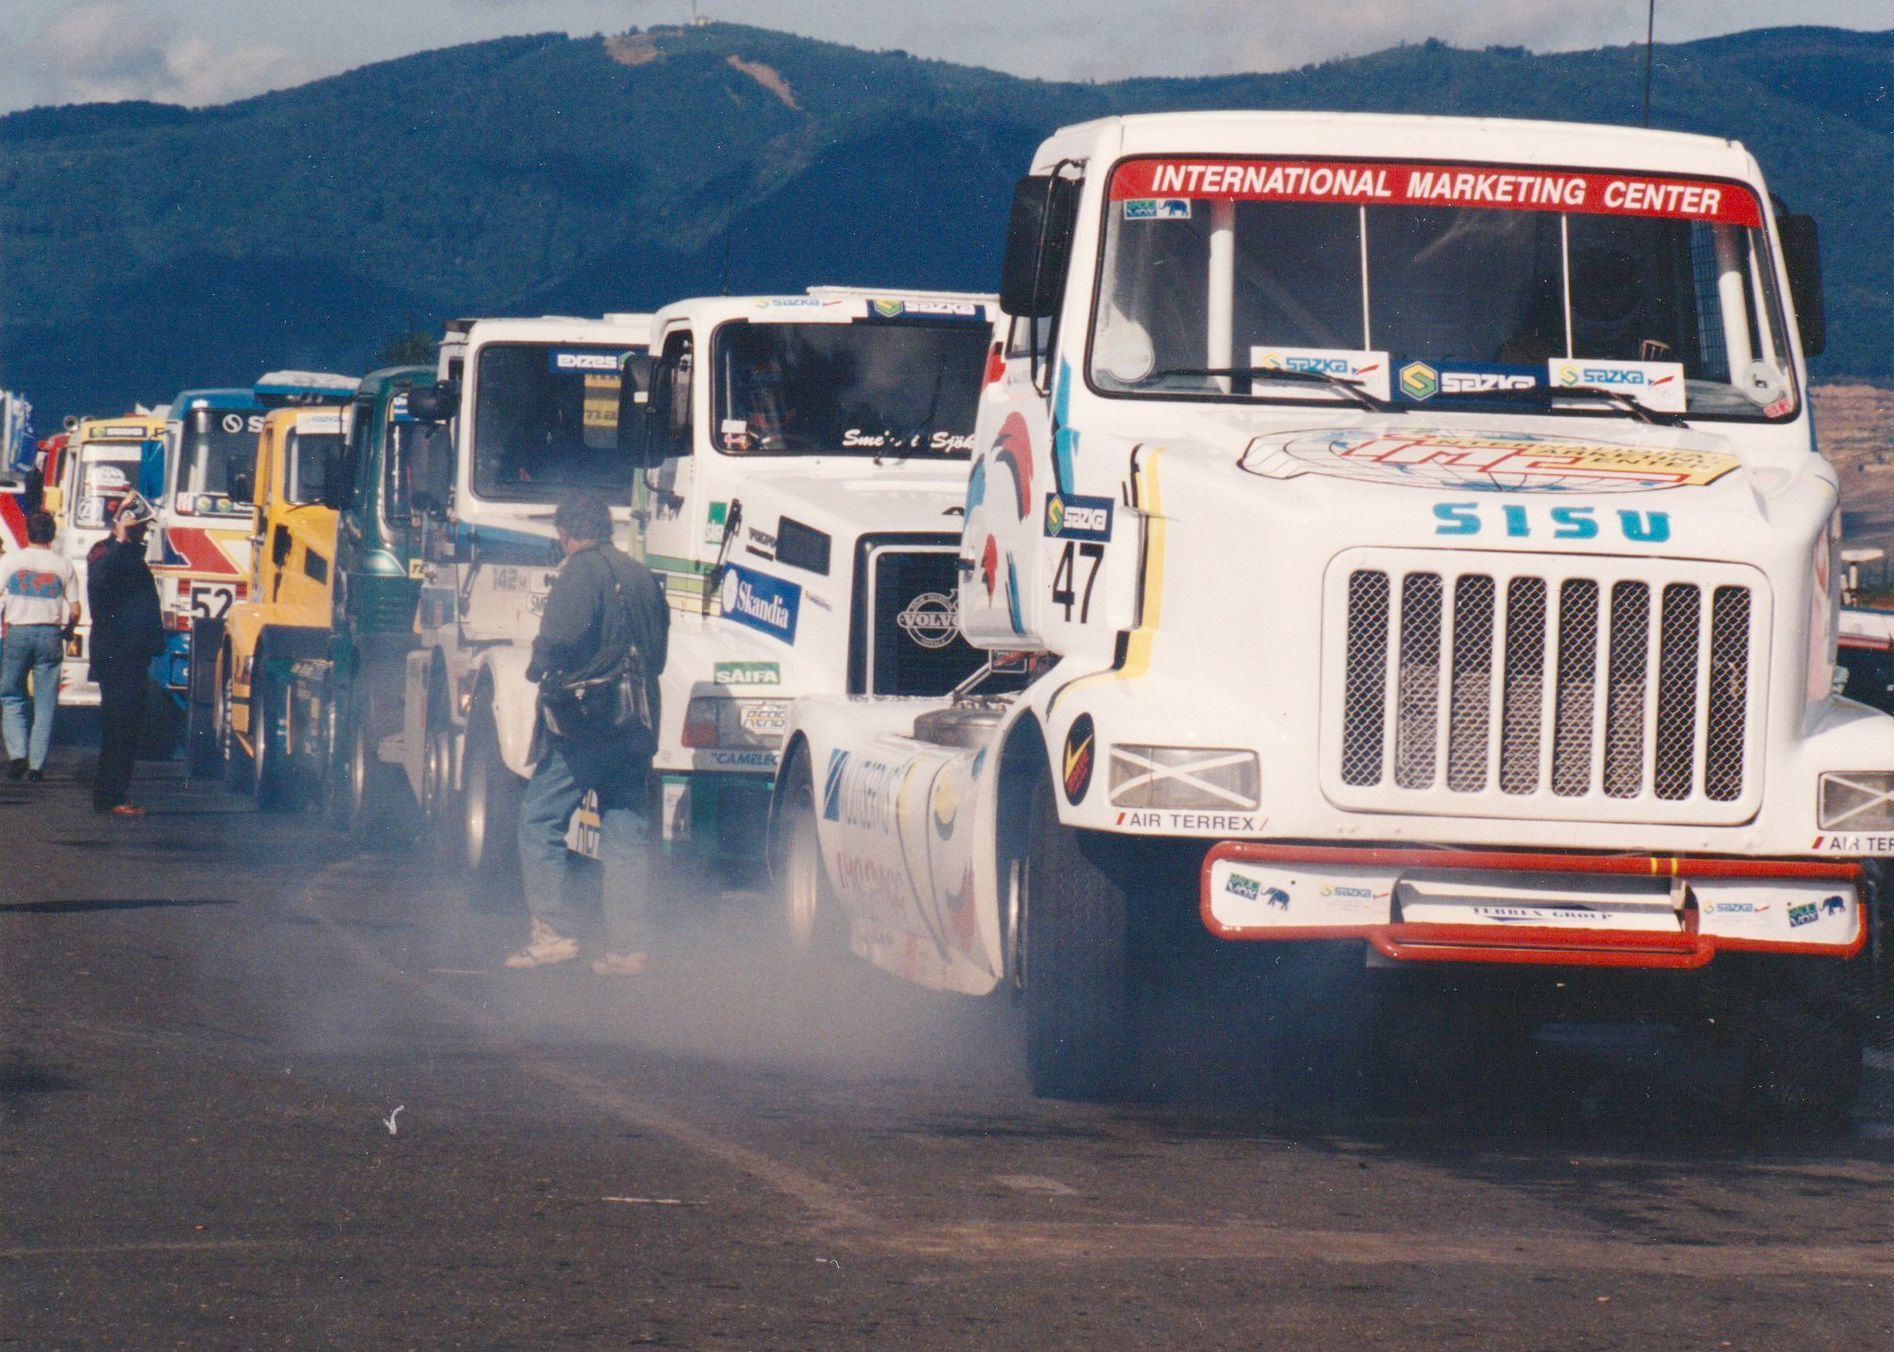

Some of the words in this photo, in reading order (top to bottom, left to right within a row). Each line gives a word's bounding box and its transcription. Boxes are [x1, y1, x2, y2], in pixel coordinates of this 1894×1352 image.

[1151, 164, 1392, 197] INTERNATIONAL
[1407, 171, 1587, 206] MARKETING
[1604, 181, 1721, 215] CENTER
[1432, 502, 1672, 543] SISU
[191, 587, 236, 619] 52
[1052, 541, 1104, 624] 47
[737, 581, 789, 630] Skandia
[1130, 813, 1161, 827] AIR
[1170, 815, 1255, 831] TERREX
[1830, 836, 1860, 851] AIR
